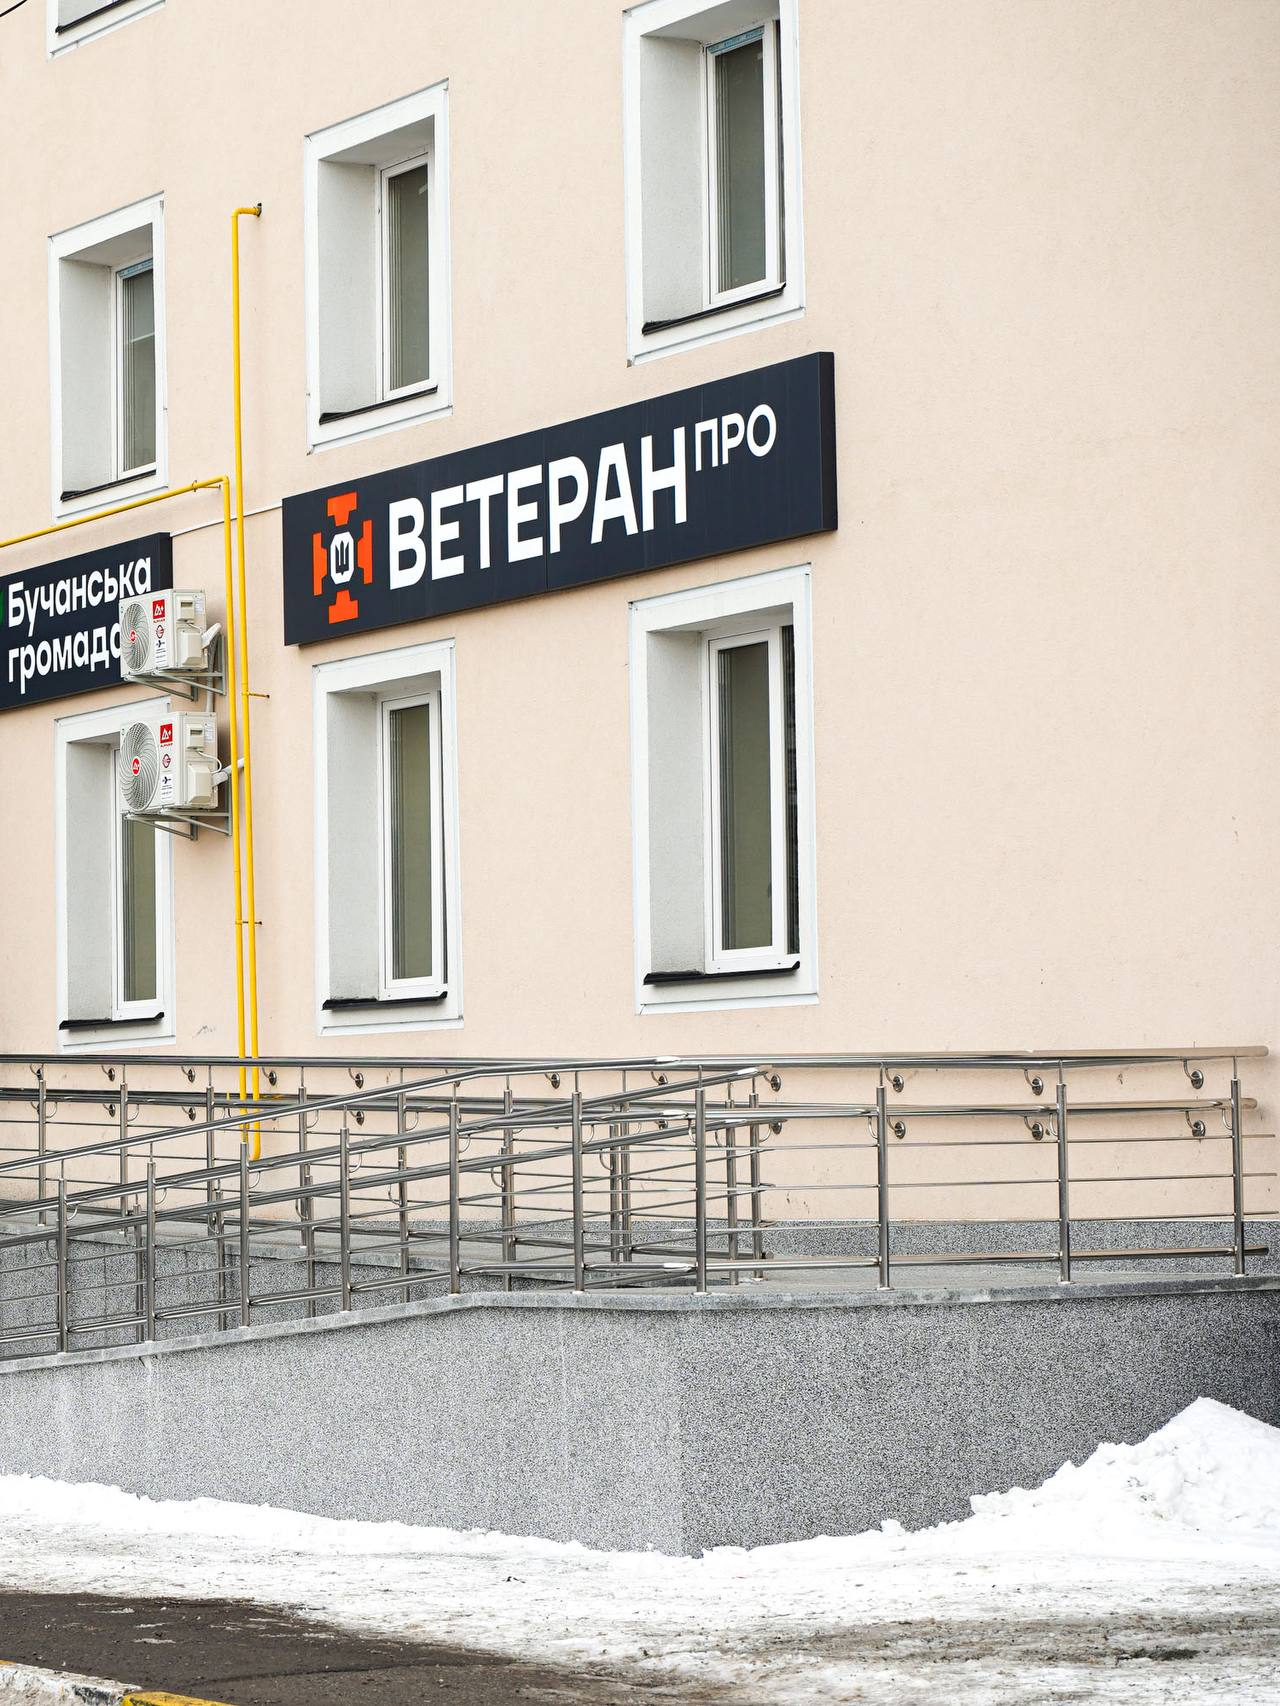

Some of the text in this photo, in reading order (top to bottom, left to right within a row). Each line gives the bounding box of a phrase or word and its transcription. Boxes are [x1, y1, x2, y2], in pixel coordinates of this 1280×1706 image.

[389, 404, 777, 590] ВЕТЕРАН ПРО
[8, 557, 151, 637] Бучанська
